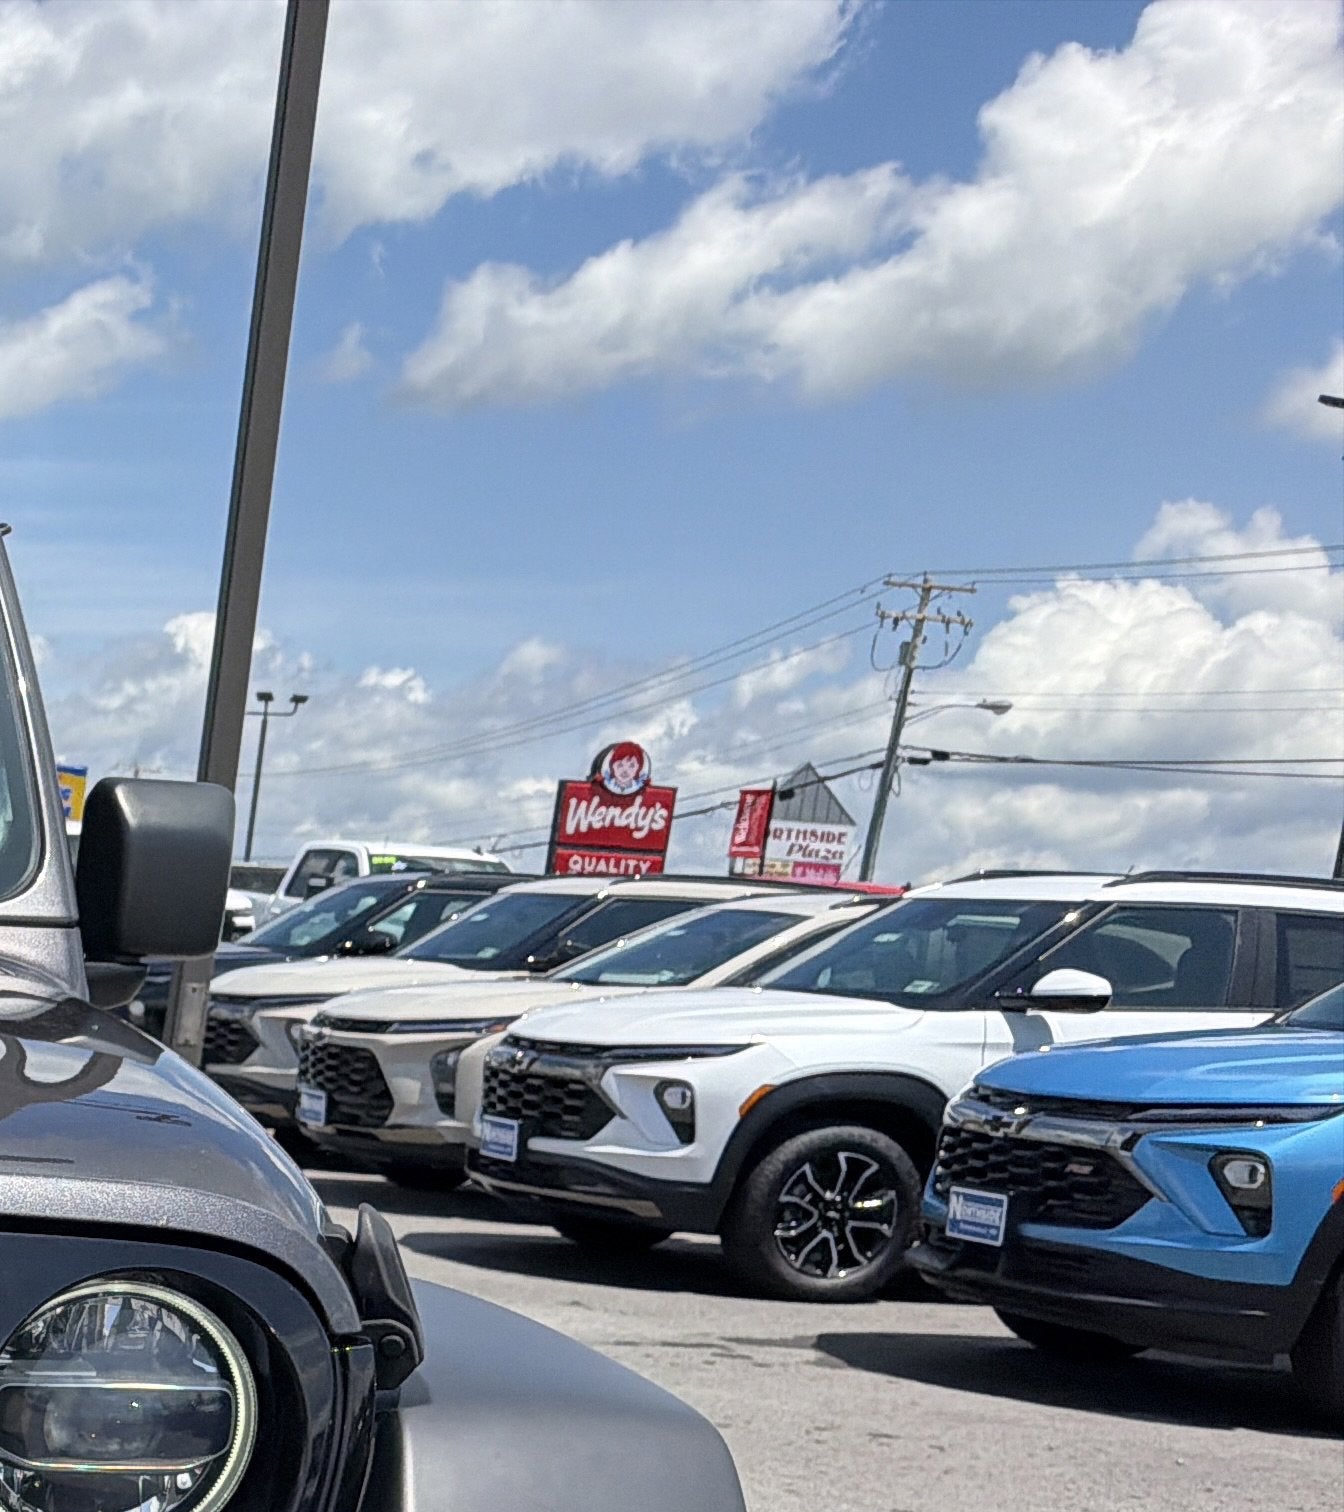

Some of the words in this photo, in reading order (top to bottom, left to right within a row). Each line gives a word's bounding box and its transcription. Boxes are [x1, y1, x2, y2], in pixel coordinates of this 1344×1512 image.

[565, 795, 669, 839] Wendy's
[786, 843, 845, 861] Plaza
[568, 855, 652, 874] QUALITY
